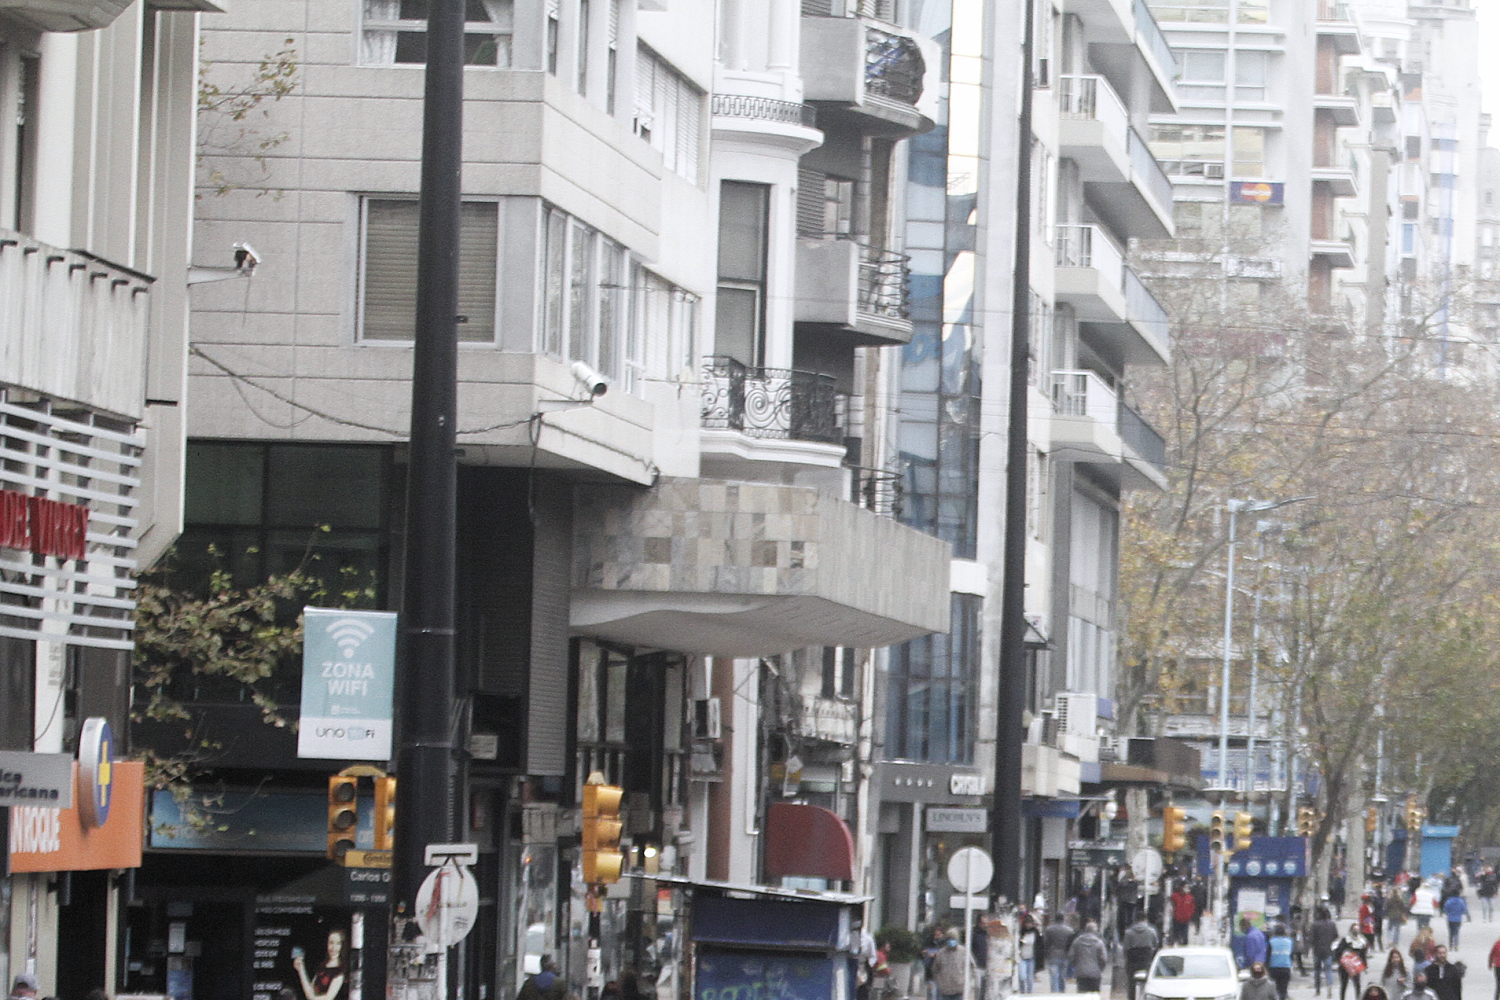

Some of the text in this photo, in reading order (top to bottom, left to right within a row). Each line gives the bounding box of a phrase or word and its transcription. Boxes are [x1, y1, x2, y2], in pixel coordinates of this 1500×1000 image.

[321, 662, 375, 679] ZONA
[328, 680, 368, 697] WIFI
[350, 871, 380, 882] Carlos
